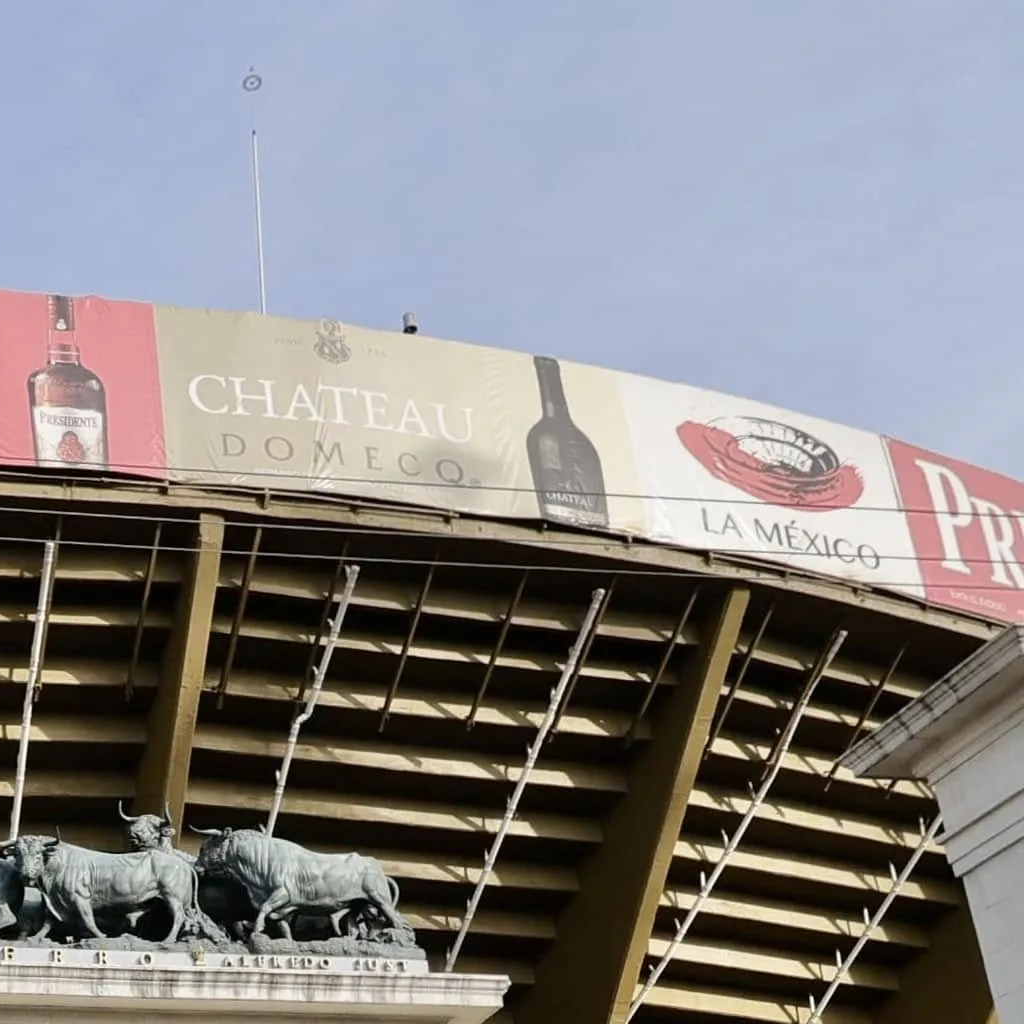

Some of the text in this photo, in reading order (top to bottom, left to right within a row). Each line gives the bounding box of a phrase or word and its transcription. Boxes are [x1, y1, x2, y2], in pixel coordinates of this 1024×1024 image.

[187, 373, 475, 444] CHATEAU
[701, 506, 881, 571] LA MÉXICO
